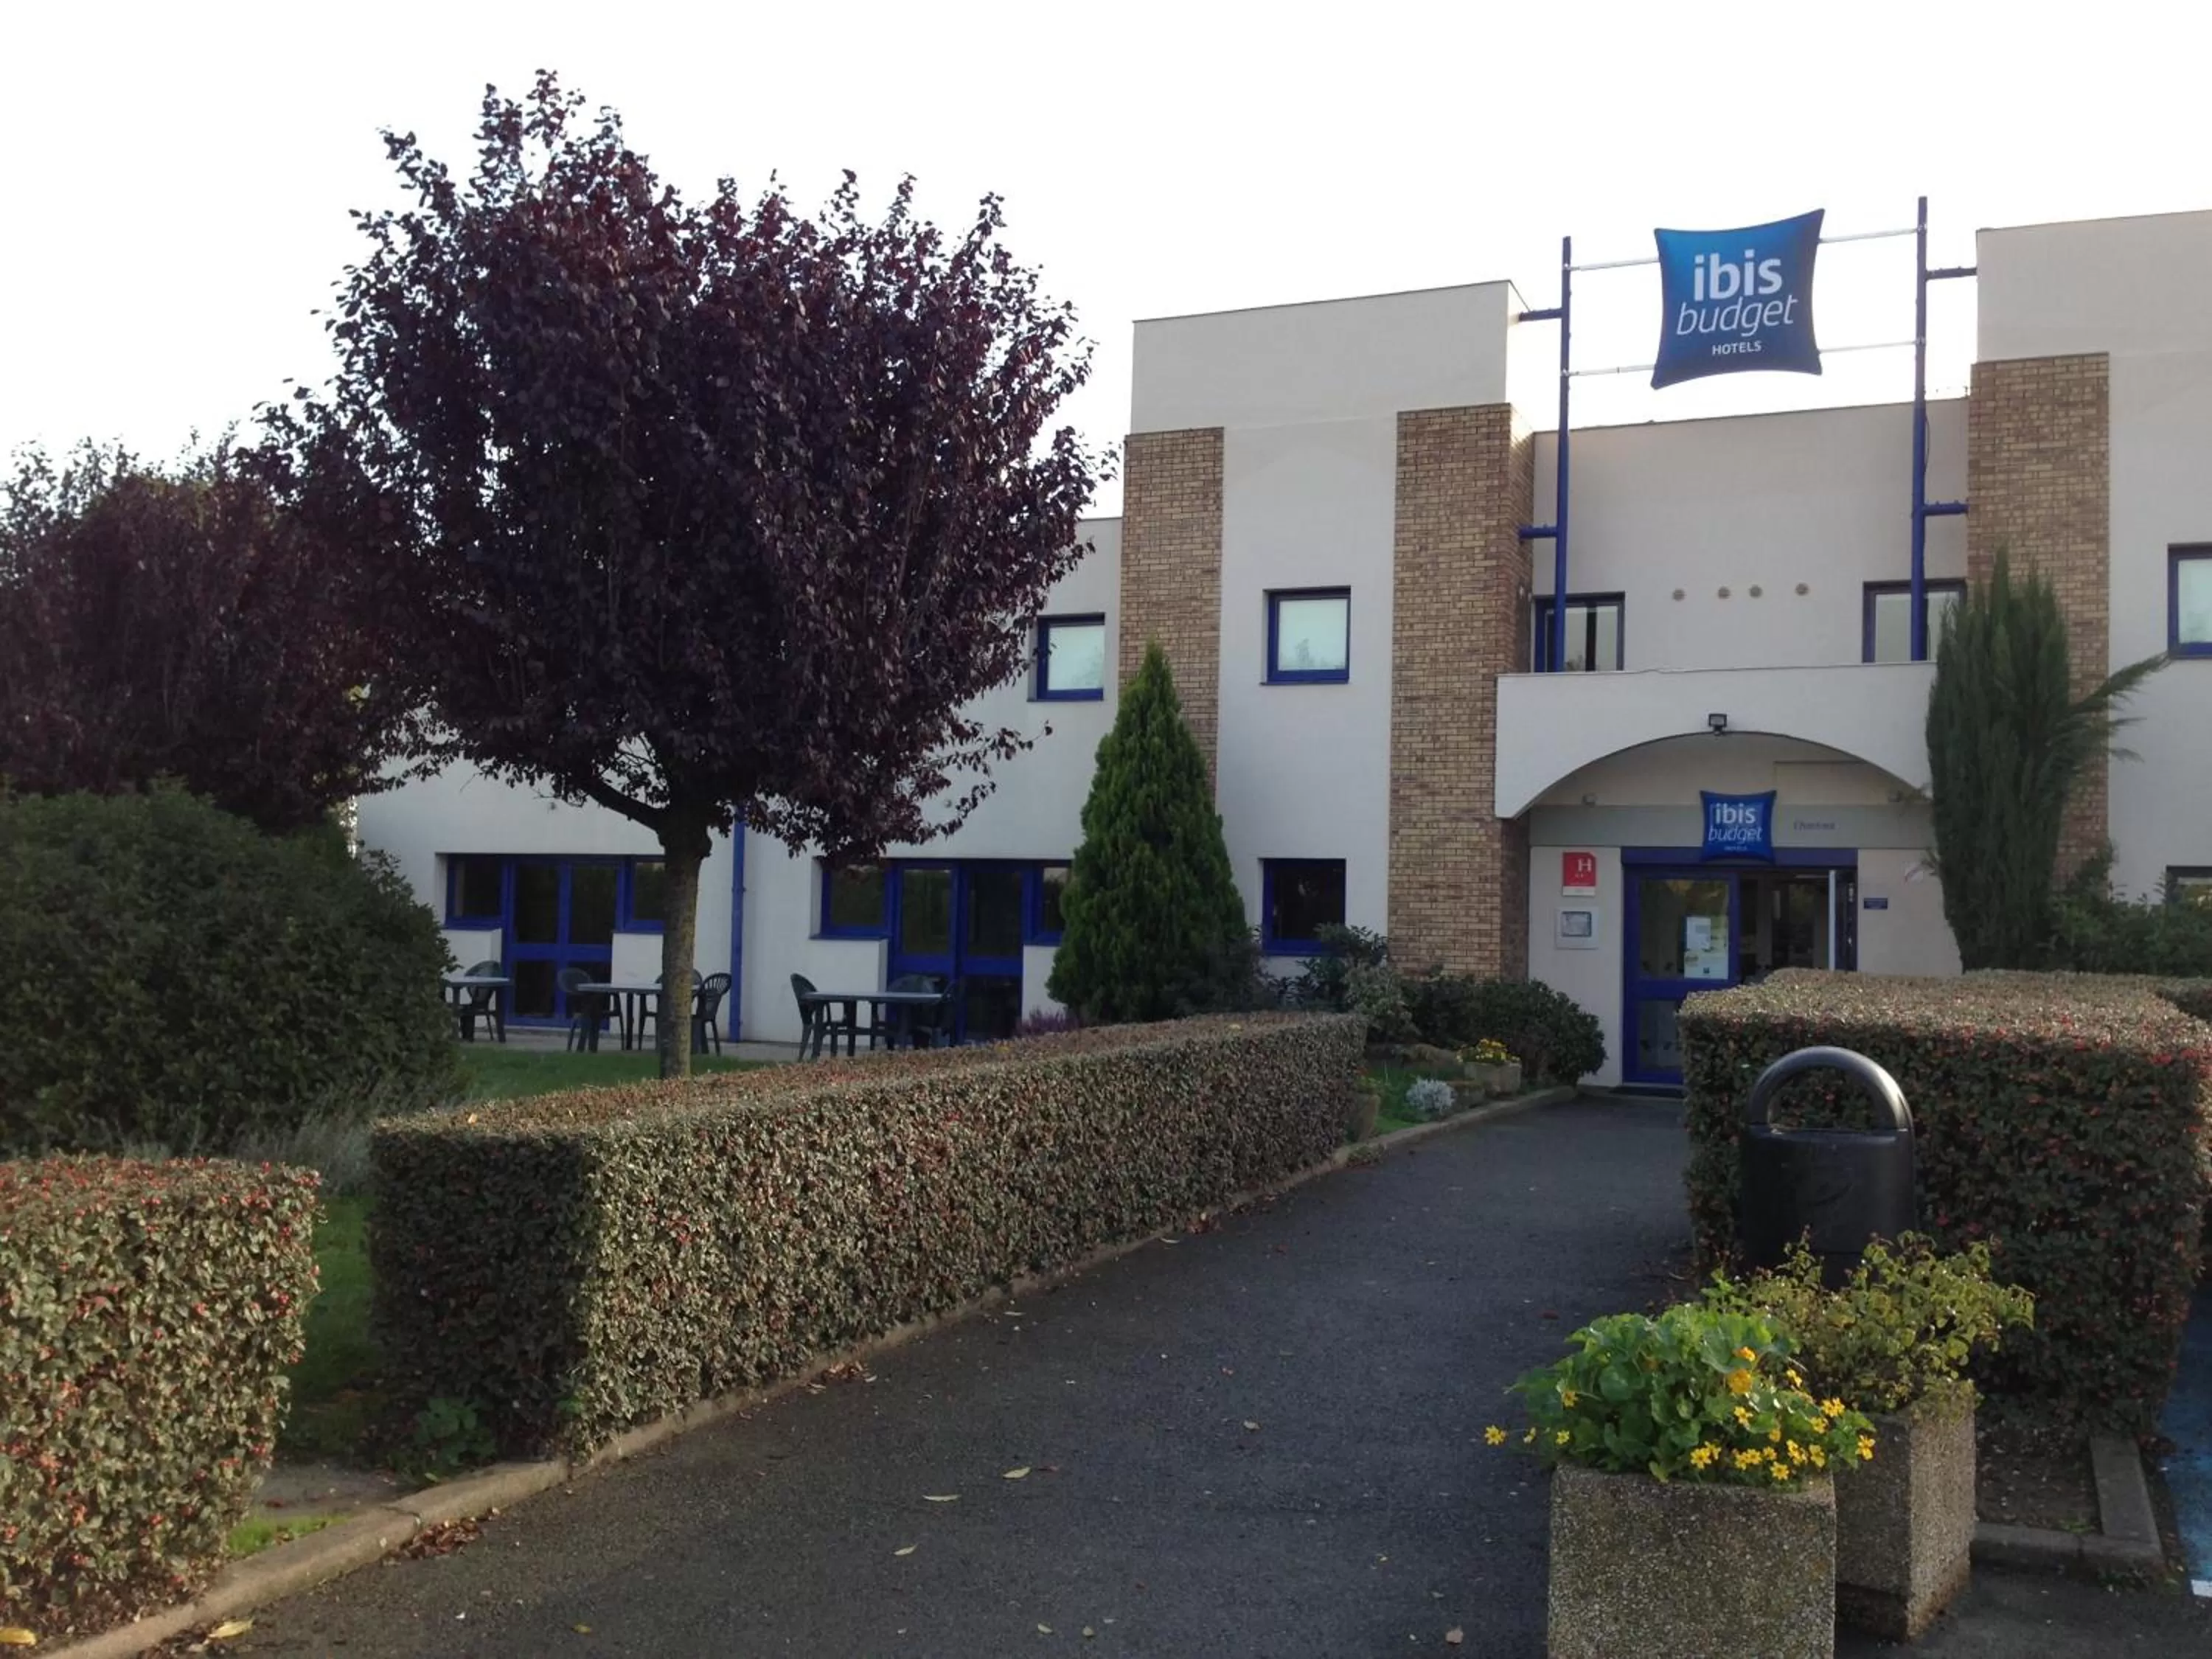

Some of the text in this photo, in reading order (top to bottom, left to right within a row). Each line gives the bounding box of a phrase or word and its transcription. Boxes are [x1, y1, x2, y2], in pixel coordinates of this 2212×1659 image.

[1694, 248, 1783, 302] ibis
[1676, 294, 1798, 337] budget
[1711, 341, 1761, 356] HOTELS
[1715, 803, 1756, 824] ibis
[1708, 825, 1763, 844] budget
[1578, 858, 1592, 873] H
